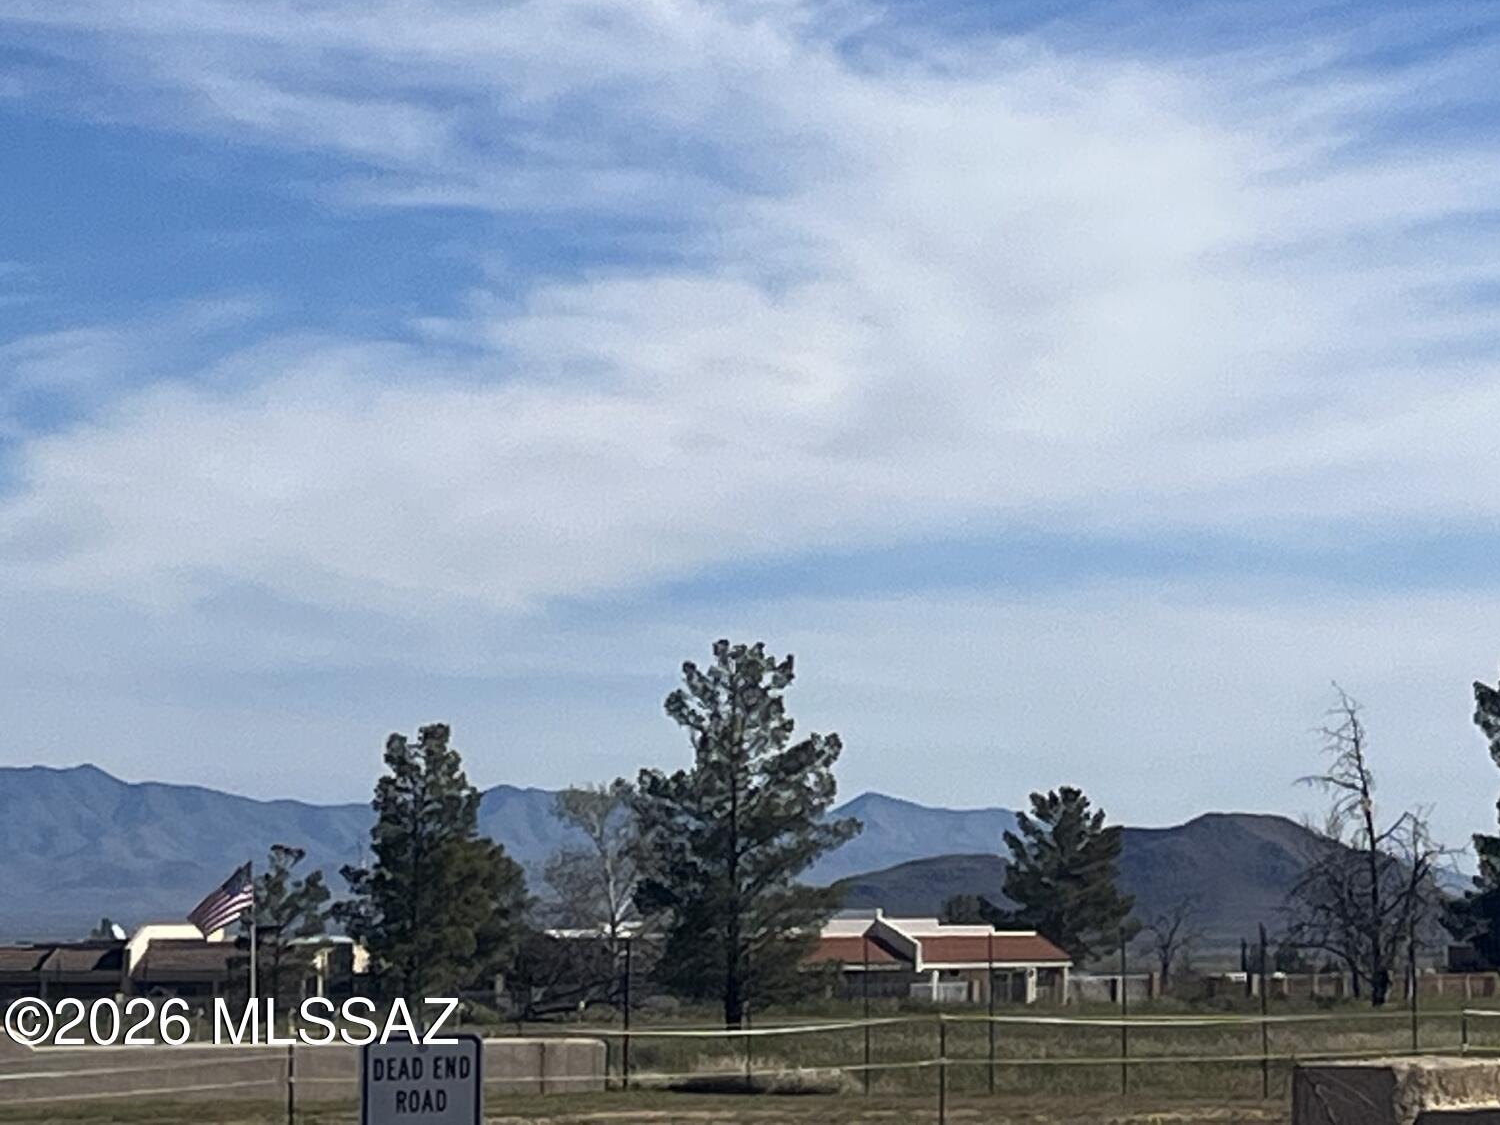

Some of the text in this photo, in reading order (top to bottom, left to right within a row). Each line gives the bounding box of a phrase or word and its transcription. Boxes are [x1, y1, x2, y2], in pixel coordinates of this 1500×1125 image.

[372, 1055, 471, 1082] DEAD END
[395, 1089, 447, 1114] ROAD
